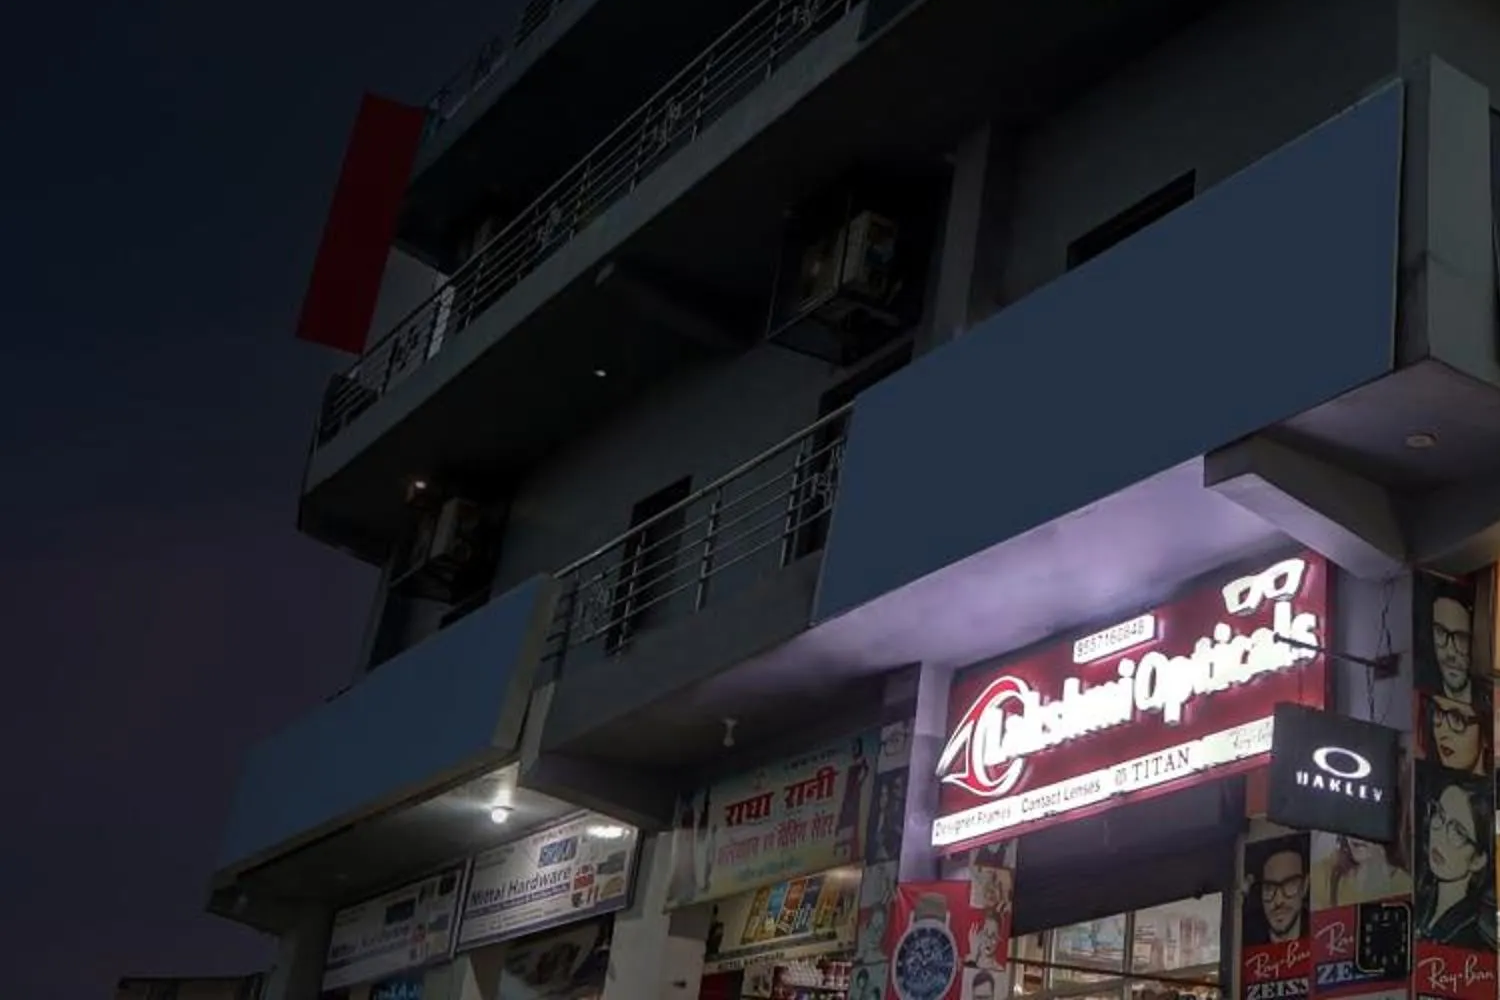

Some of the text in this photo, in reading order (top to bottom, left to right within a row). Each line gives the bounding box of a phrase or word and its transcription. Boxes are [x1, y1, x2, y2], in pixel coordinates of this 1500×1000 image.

[1136, 599, 1319, 724] Opticals
[1020, 785, 1062, 815] Contact
[1063, 777, 1101, 803] Lenses
[1133, 748, 1190, 783] TITAN
[1296, 770, 1383, 802] OAKLEY
[725, 792, 774, 828] राधा
[508, 866, 573, 898] Hardware
[1246, 944, 1311, 978] Ray-Ban
[1417, 954, 1494, 994] Ray-Ban
[1247, 979, 1309, 999] ZEISS
